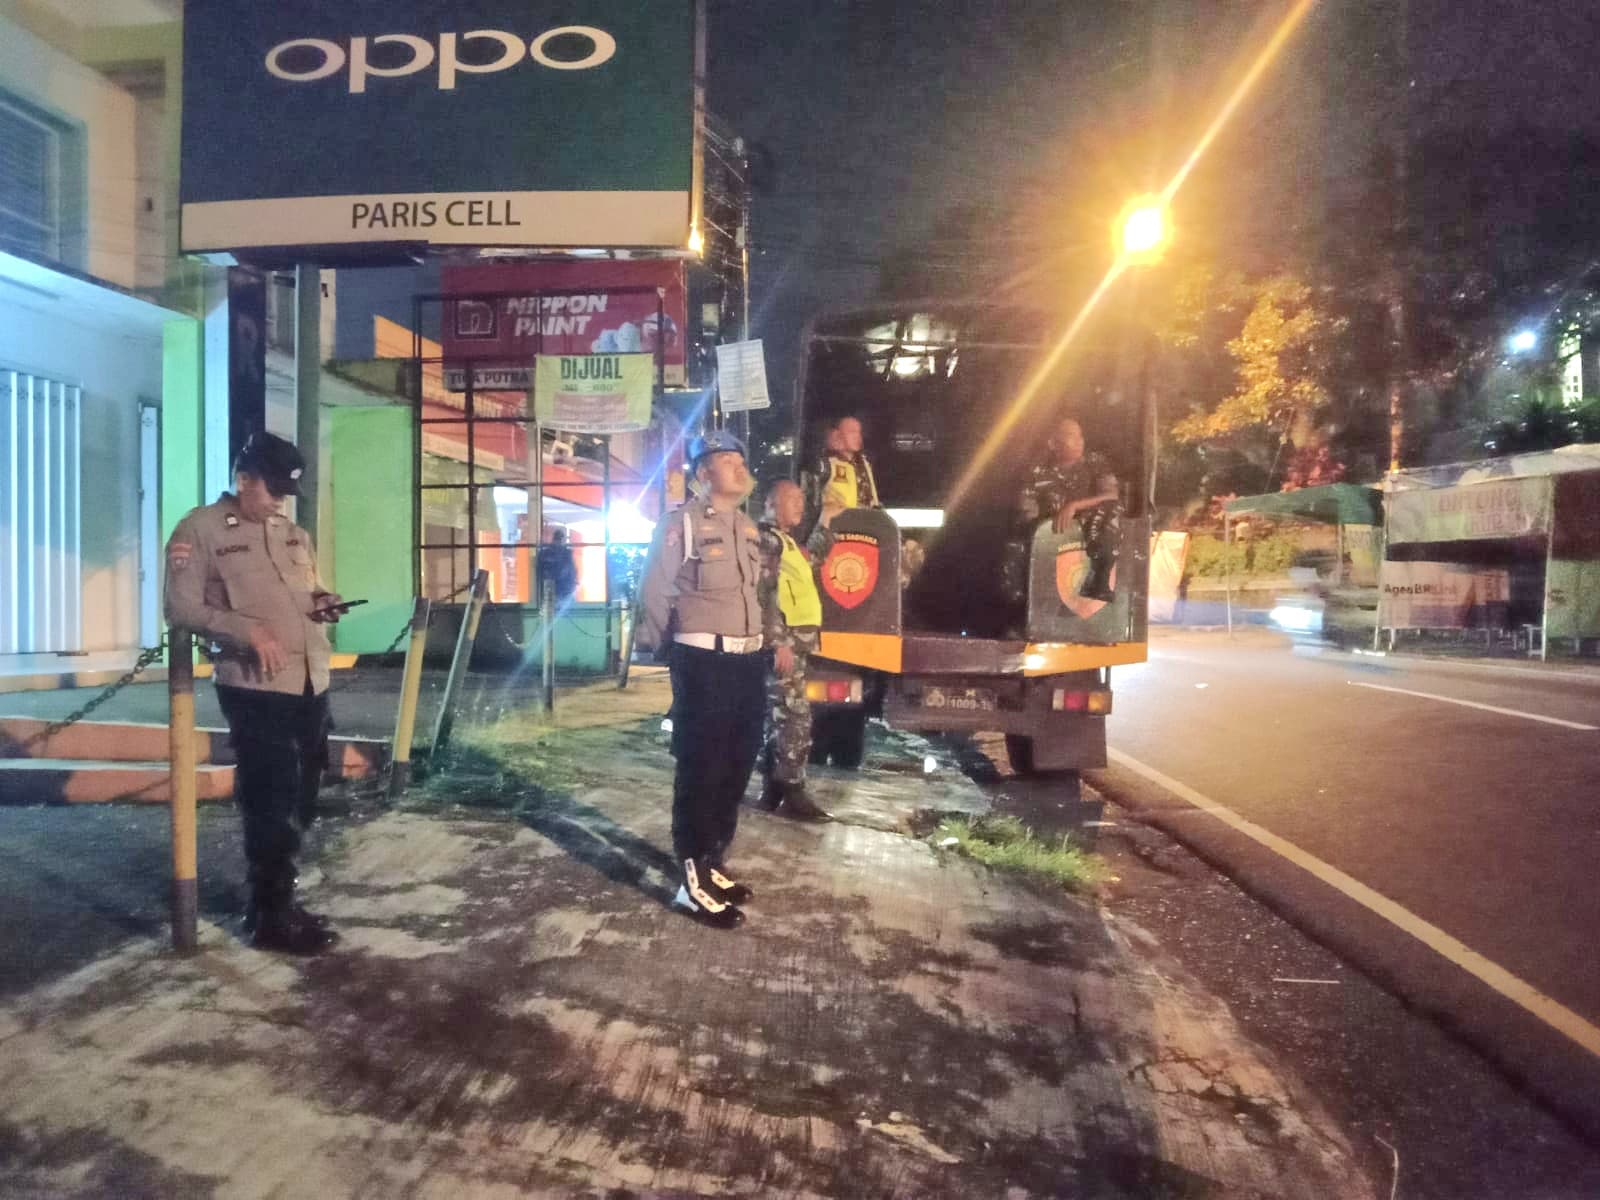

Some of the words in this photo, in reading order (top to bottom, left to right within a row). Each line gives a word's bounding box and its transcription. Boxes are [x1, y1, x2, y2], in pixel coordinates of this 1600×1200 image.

[351, 201, 437, 229] PARIS
[445, 199, 521, 226] CELL
[506, 294, 608, 315] NIPPON
[514, 315, 592, 337] PAINT
[560, 356, 623, 380] DIJUAL
